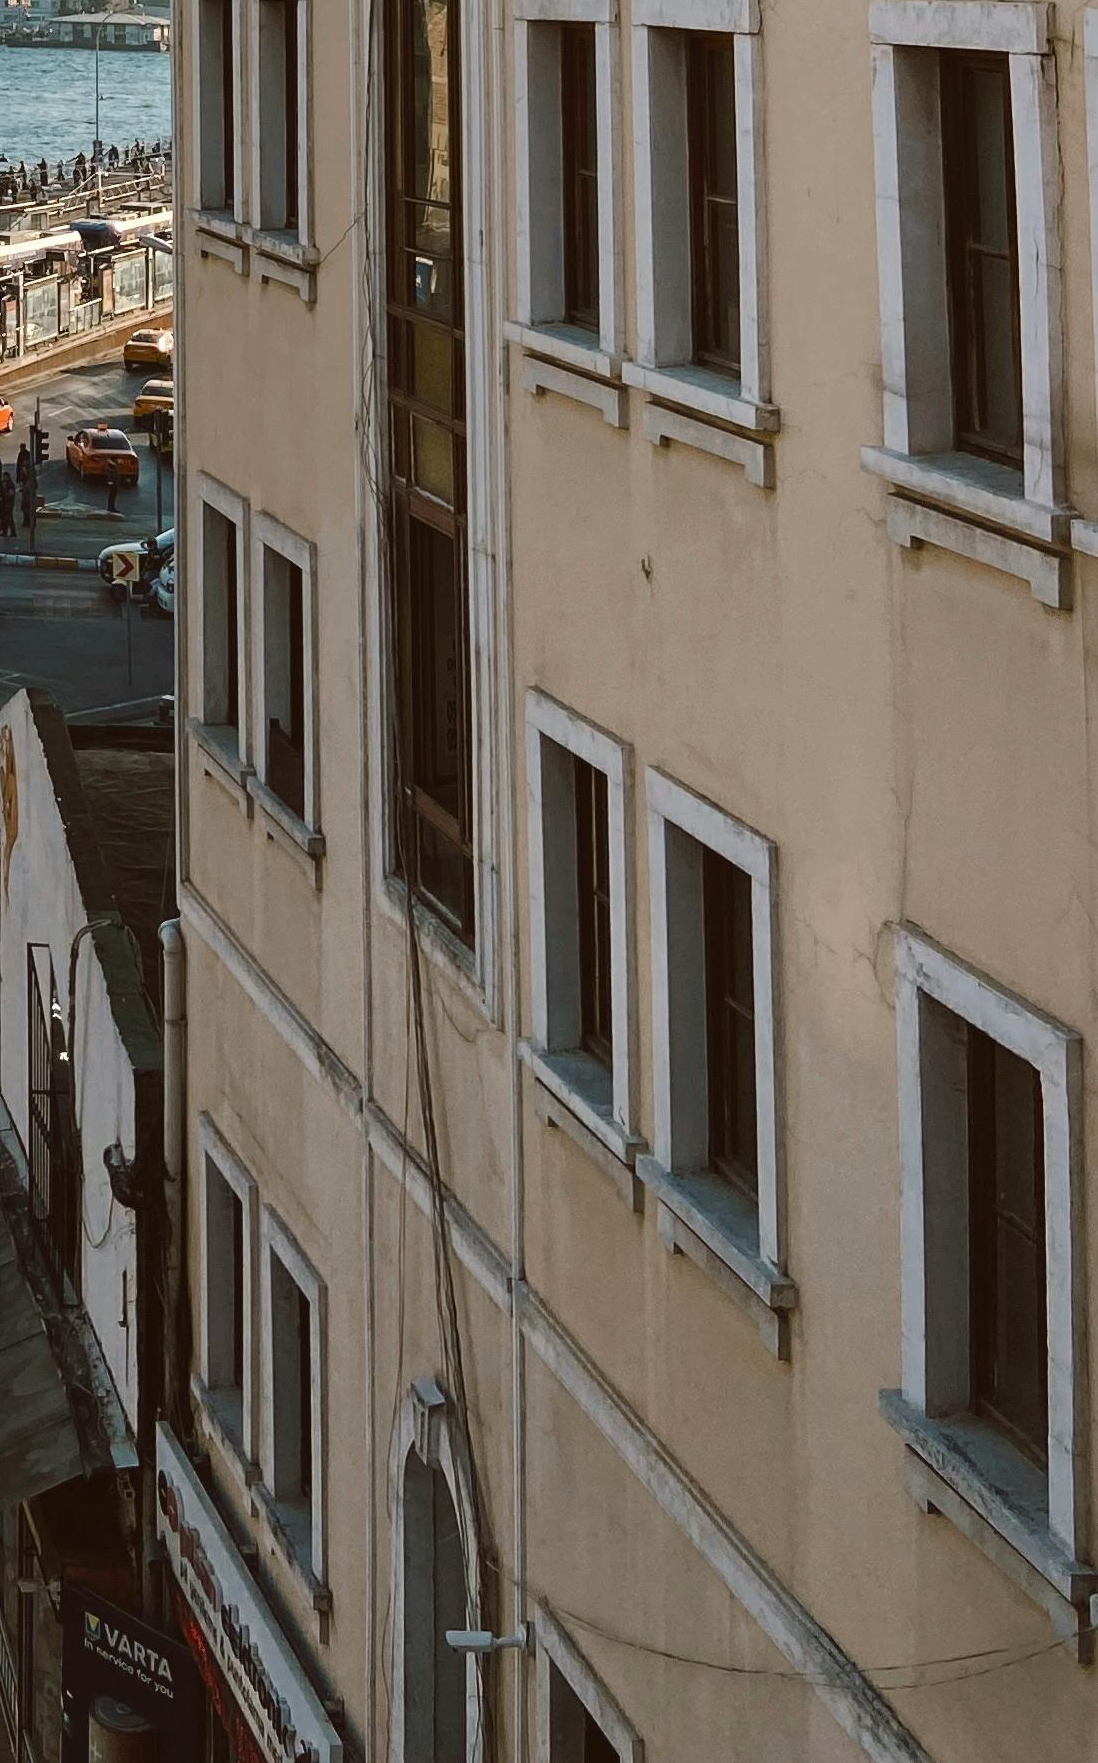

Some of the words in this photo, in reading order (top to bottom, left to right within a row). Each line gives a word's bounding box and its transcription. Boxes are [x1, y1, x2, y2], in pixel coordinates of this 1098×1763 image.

[96, 1647, 134, 1675] service
[137, 1669, 152, 1684] for
[154, 1681, 174, 1699] you
[104, 1623, 173, 1682] VARTA
